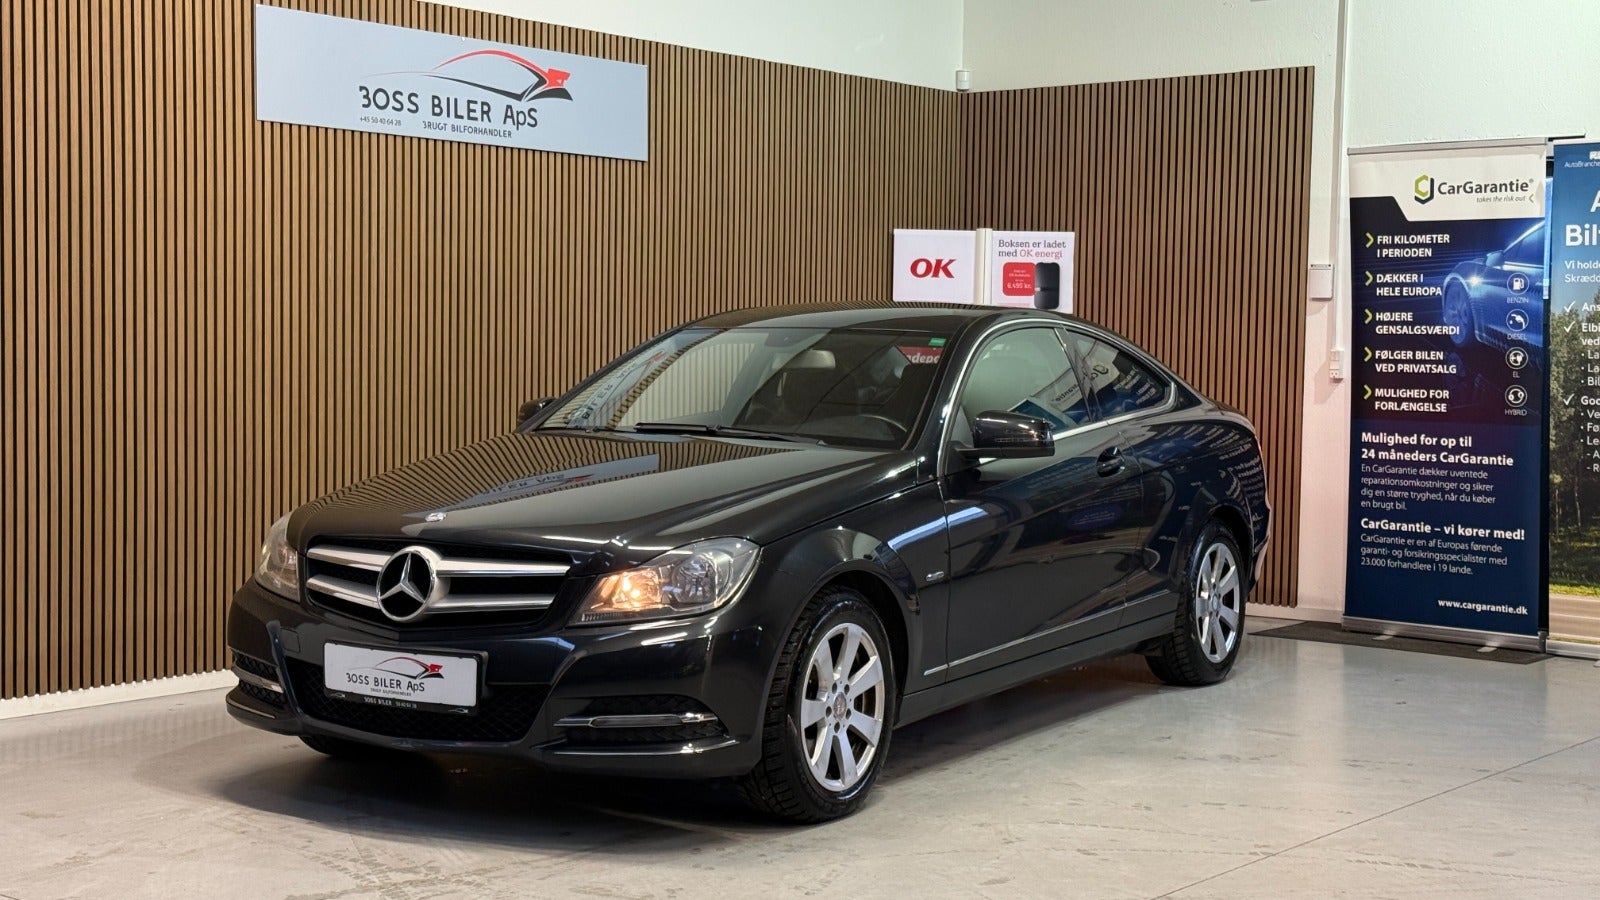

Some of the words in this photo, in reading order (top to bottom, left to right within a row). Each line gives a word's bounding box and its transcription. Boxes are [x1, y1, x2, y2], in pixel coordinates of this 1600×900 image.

[431, 95, 492, 123] BILER
[503, 104, 538, 131] ApS
[451, 124, 512, 138] BILFORHANDLER
[1377, 235, 1391, 245] FRI
[1394, 234, 1450, 244] KILOMETER
[1565, 224, 1600, 246] Bil
[998, 239, 1030, 248] Boksen
[1043, 240, 1067, 249] ladet
[998, 249, 1018, 257] med
[1019, 249, 1033, 257] OK
[1035, 250, 1063, 260] energi
[1377, 249, 1380, 258] I
[1382, 248, 1432, 257] PERIODEN
[910, 258, 956, 278] OK
[1564, 260, 1575, 269] Vi
[1376, 274, 1418, 283] DÆKKER
[1376, 287, 1400, 296] HELE
[1403, 287, 1442, 296] EUROPA
[1375, 312, 1413, 321] HØJERE
[1375, 325, 1459, 335] GENSALGSVÆRDI
[1375, 350, 1413, 360] FØLGER
[1415, 351, 1443, 360] BILEN
[1375, 363, 1395, 373] VED
[1397, 364, 1457, 374] PRIVATSALG
[1375, 388, 1427, 399] MULIGHED
[1429, 389, 1449, 399] FOR
[1375, 401, 1447, 412] FORLÆNGELSE
[1361, 432, 1417, 446] Mulighed
[1420, 434, 1437, 446] for
[1440, 438, 1456, 449] op
[1459, 436, 1472, 447] til
[1361, 448, 1375, 459] 24
[1378, 450, 1437, 462] måneders
[1439, 452, 1514, 466] CarGarantie
[1361, 464, 1371, 472] En
[1372, 464, 1418, 475] CarGarantie
[1419, 467, 1448, 477] dækker
[1450, 469, 1488, 479] uventede
[1361, 477, 1458, 491] reparationsomkostninger
[1459, 483, 1471, 491] og
[1472, 482, 1494, 492] sikrer
[1361, 488, 1373, 497] dig
[1387, 489, 1409, 498] større
[1410, 491, 1444, 501] tryghed,
[1445, 492, 1458, 501] når
[1459, 494, 1471, 503] du
[1472, 495, 1496, 504] køber
[1372, 500, 1394, 510] brugt
[1395, 502, 1407, 511] bil.
[1361, 518, 1432, 533] CarGarantie
[1443, 524, 1455, 535] vi
[1457, 524, 1491, 538] kører
[1493, 529, 1525, 541] med!
[1361, 533, 1406, 545] CarGarantie
[1416, 539, 1427, 547] en
[1428, 539, 1436, 548] af
[1437, 540, 1469, 551] Europas
[1470, 541, 1502, 553] førende
[1361, 546, 1390, 556] garanti-
[1391, 549, 1403, 559] og
[1404, 549, 1487, 564] forsikringsspecialister
[1488, 557, 1508, 566] med
[1361, 557, 1386, 567] 23.000
[1387, 559, 1432, 571] forhandlere
[1438, 564, 1448, 572] 19
[1449, 565, 1474, 575] lande.
[1437, 599, 1528, 615] www.cargarantie.dk
[374, 677, 402, 690] BILER
[406, 681, 425, 694] ApS
